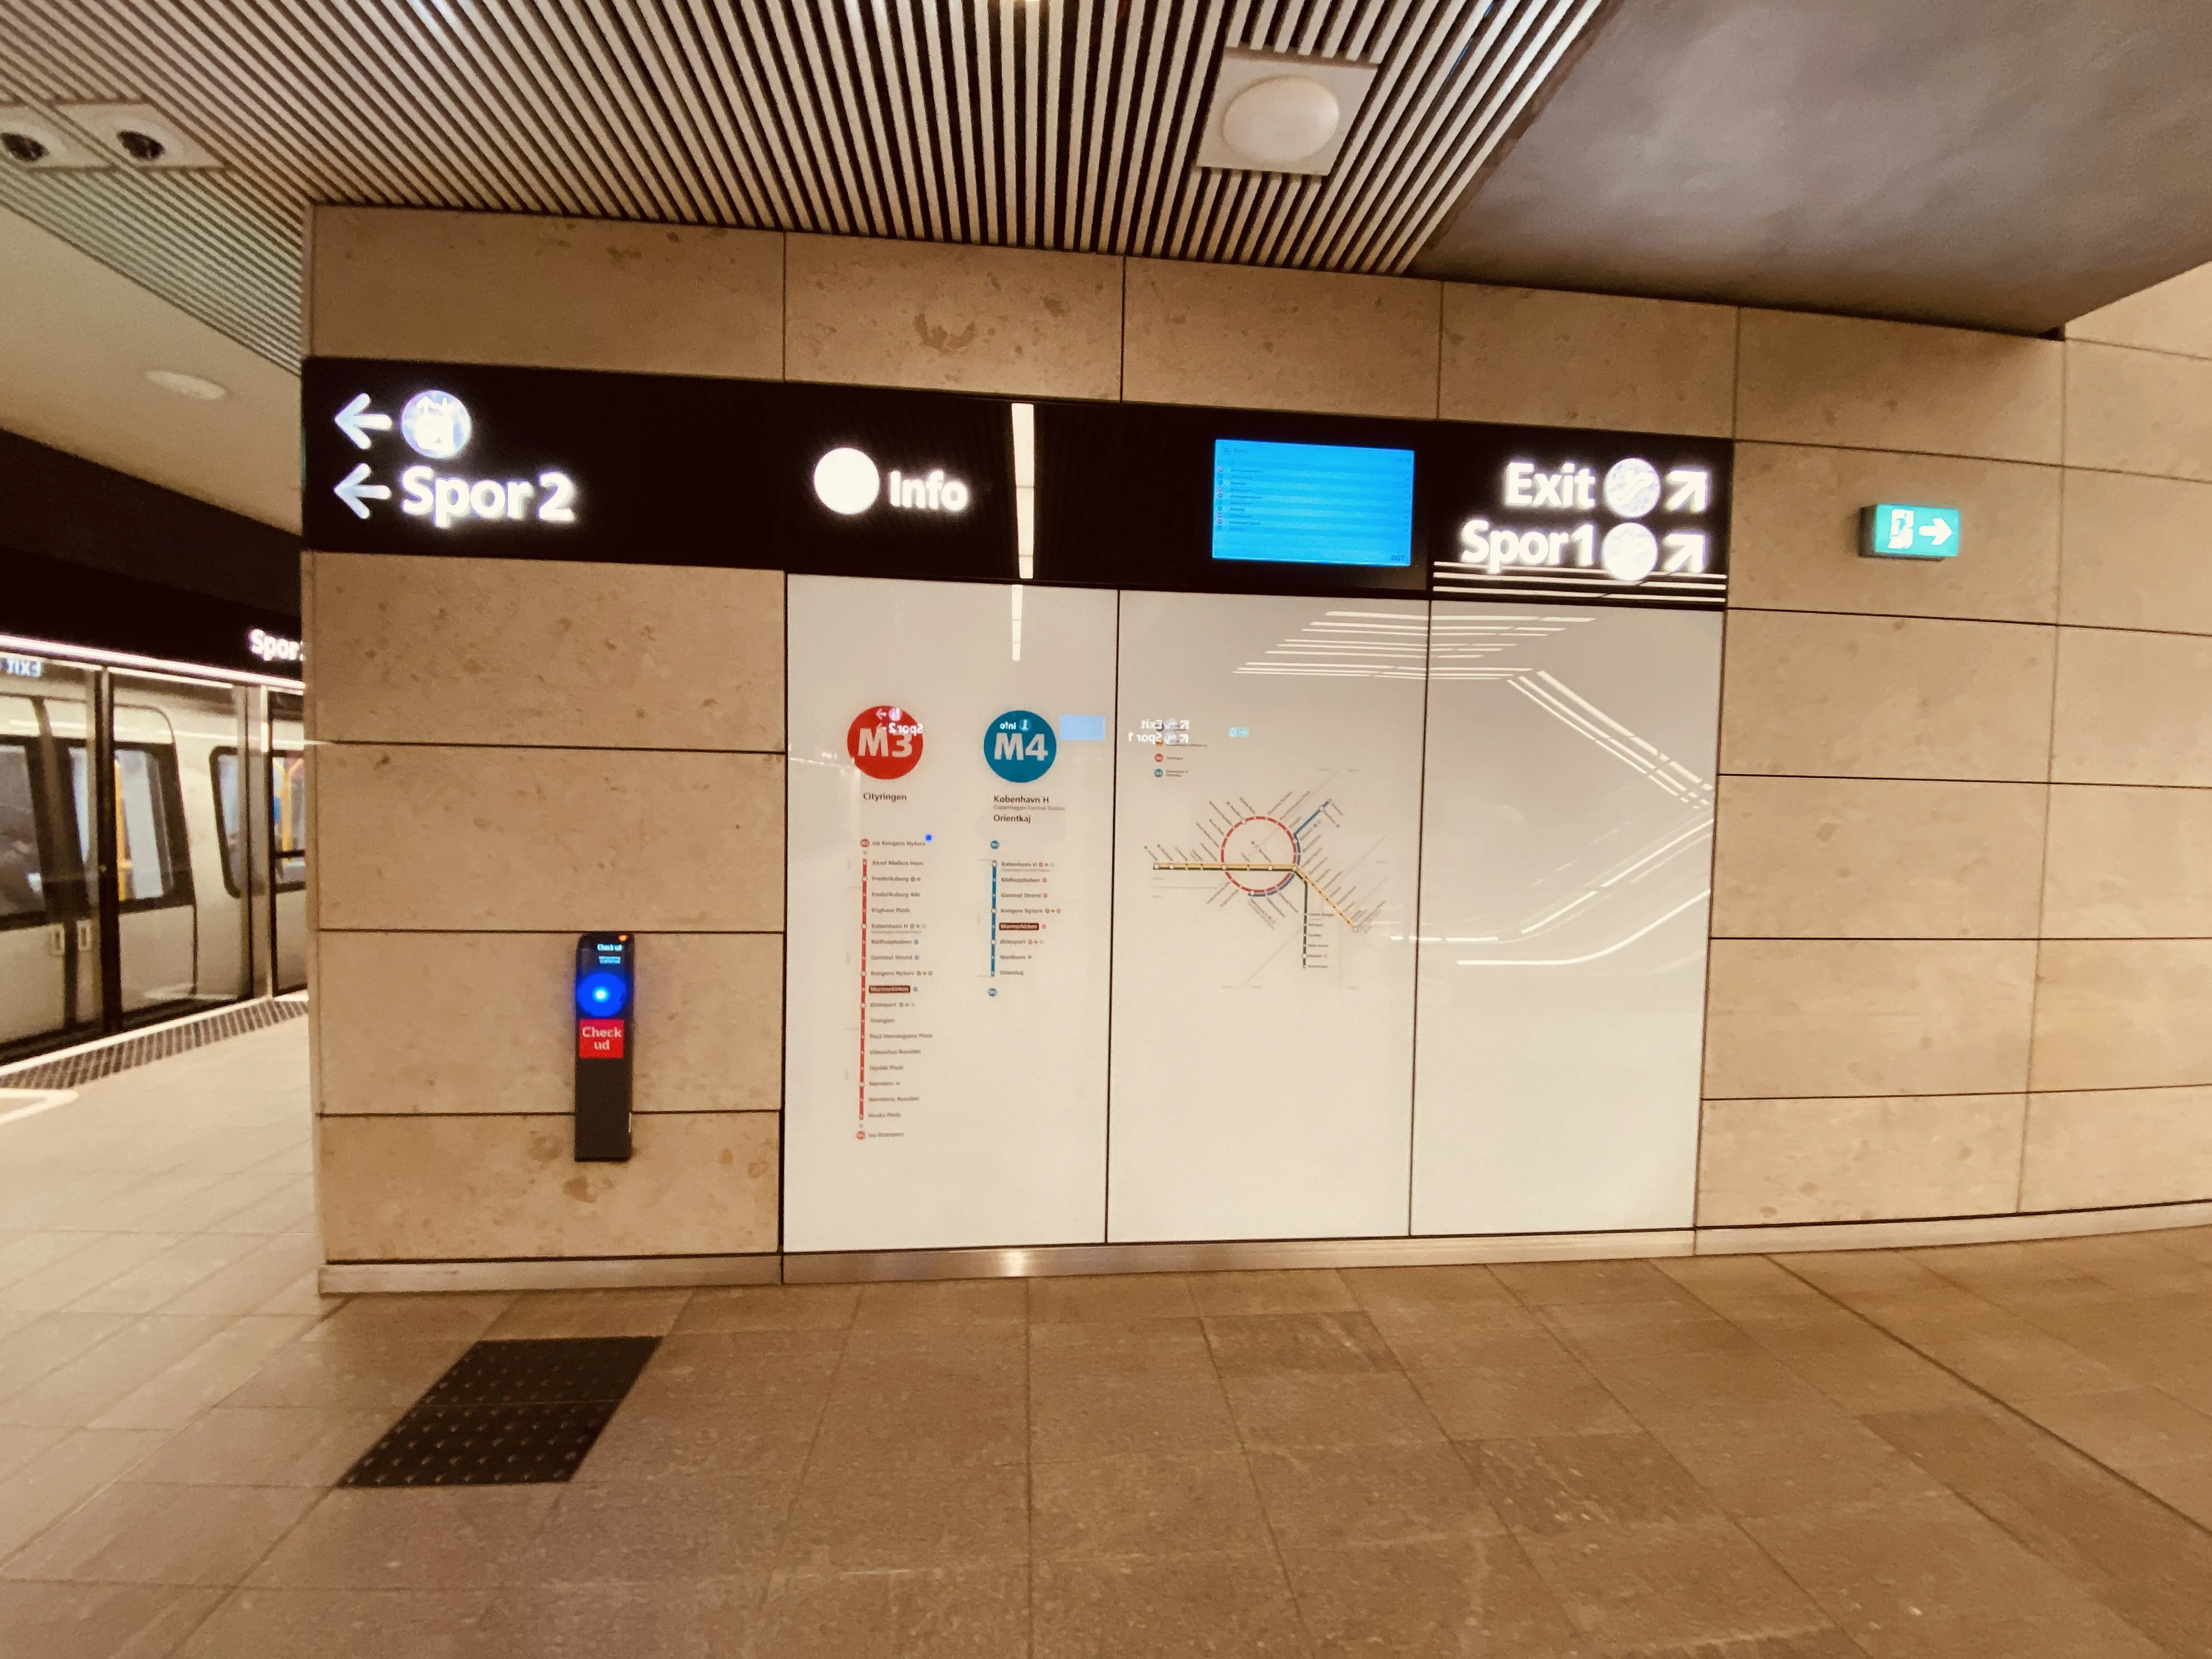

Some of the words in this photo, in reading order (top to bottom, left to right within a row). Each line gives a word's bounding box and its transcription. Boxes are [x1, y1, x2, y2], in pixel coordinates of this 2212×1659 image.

[401, 465, 535, 528] Spor
[537, 472, 575, 522] 2
[889, 470, 968, 511] Info
[1506, 462, 1596, 508] Exit
[1462, 519, 1570, 574] Spor
[1571, 524, 1594, 566] 1
[251, 629, 300, 662] Spor
[858, 727, 913, 758] M3
[994, 732, 1048, 761] M4
[864, 792, 907, 802] Cityringen
[994, 814, 1031, 823] Orientkaj
[582, 1026, 622, 1039] Check
[594, 1040, 610, 1051] ud
